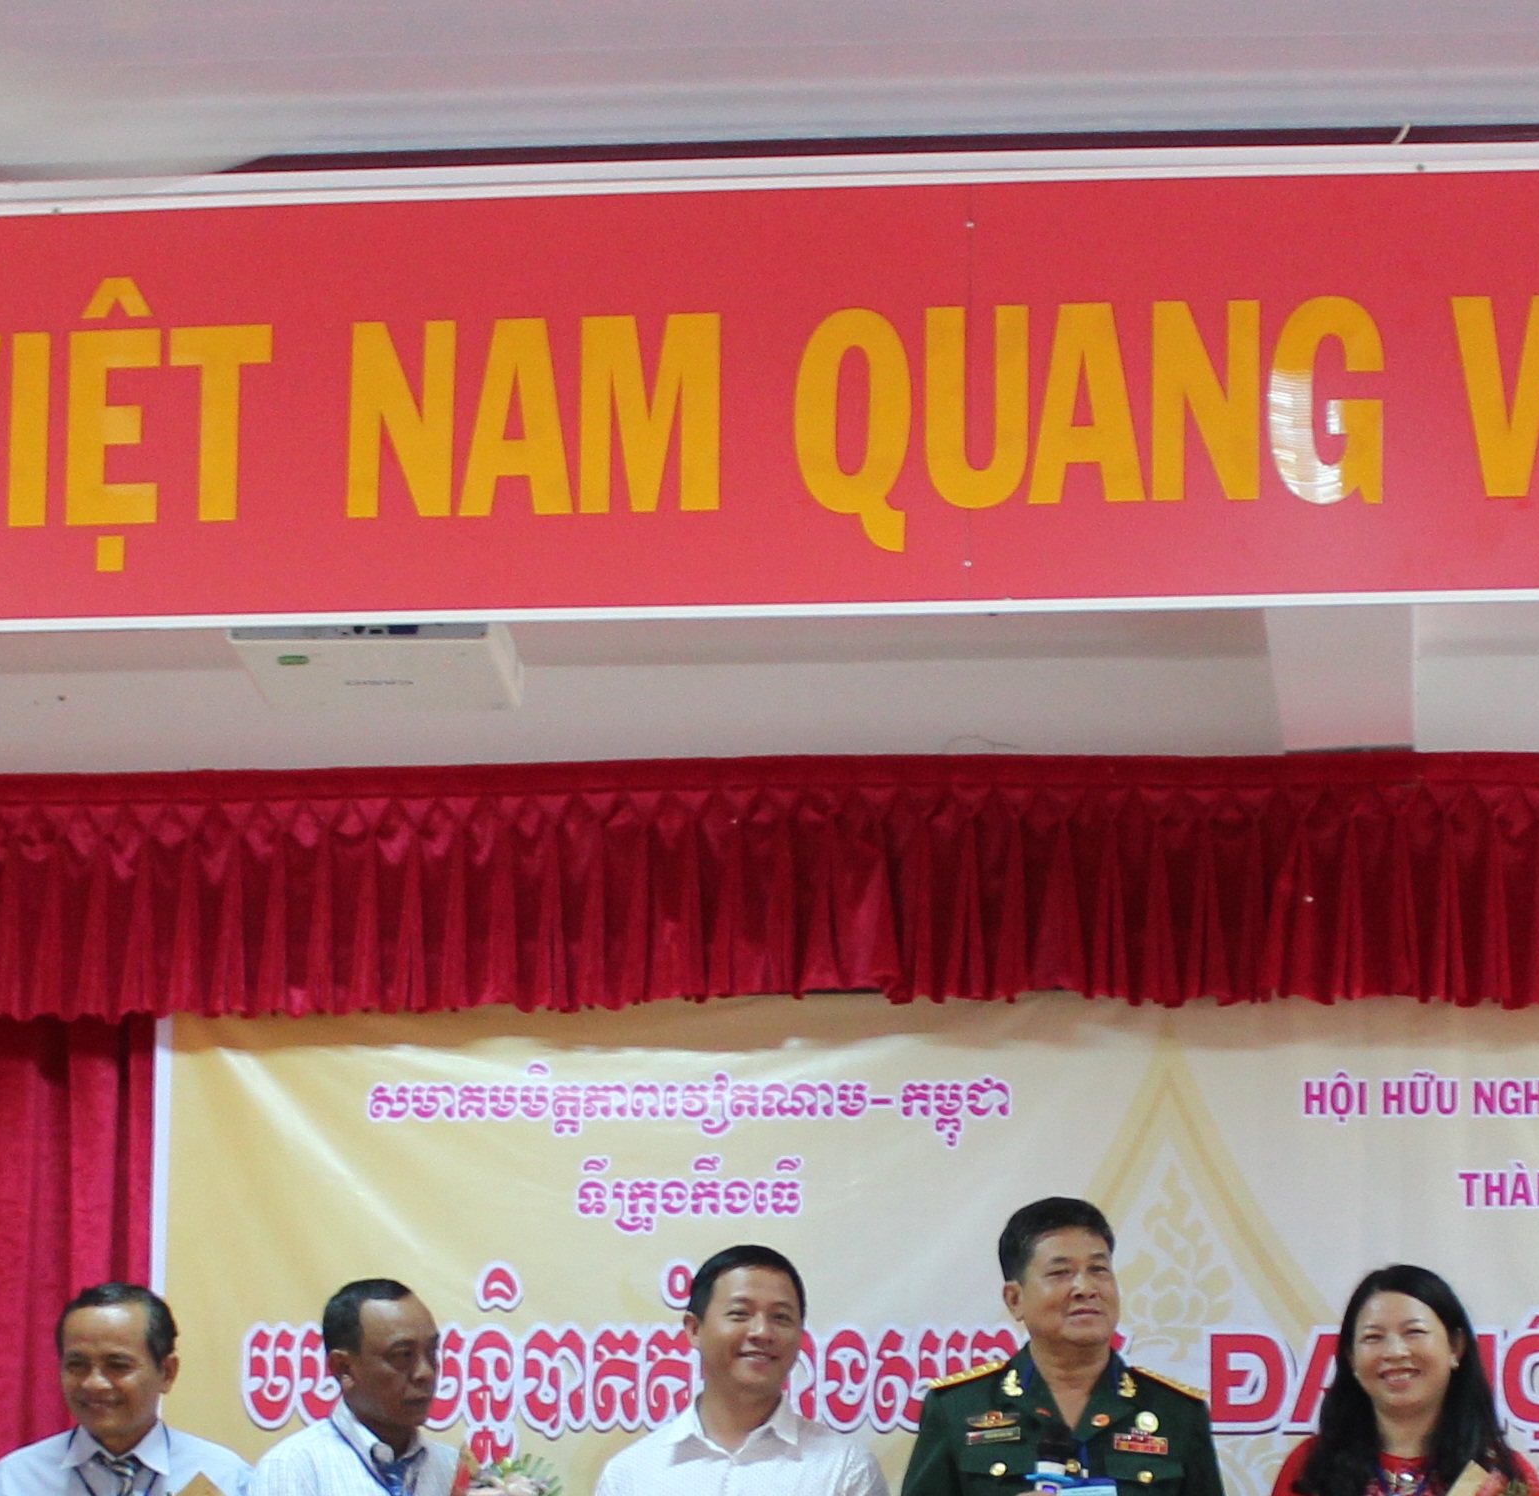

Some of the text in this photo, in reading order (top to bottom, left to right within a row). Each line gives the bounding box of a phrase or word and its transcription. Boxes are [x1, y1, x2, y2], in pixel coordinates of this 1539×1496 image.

[348, 312, 720, 520] NAM
[794, 295, 1384, 552] QUANG
[1304, 1071, 1367, 1123] HỘI
[1382, 1071, 1459, 1116] HỮU
